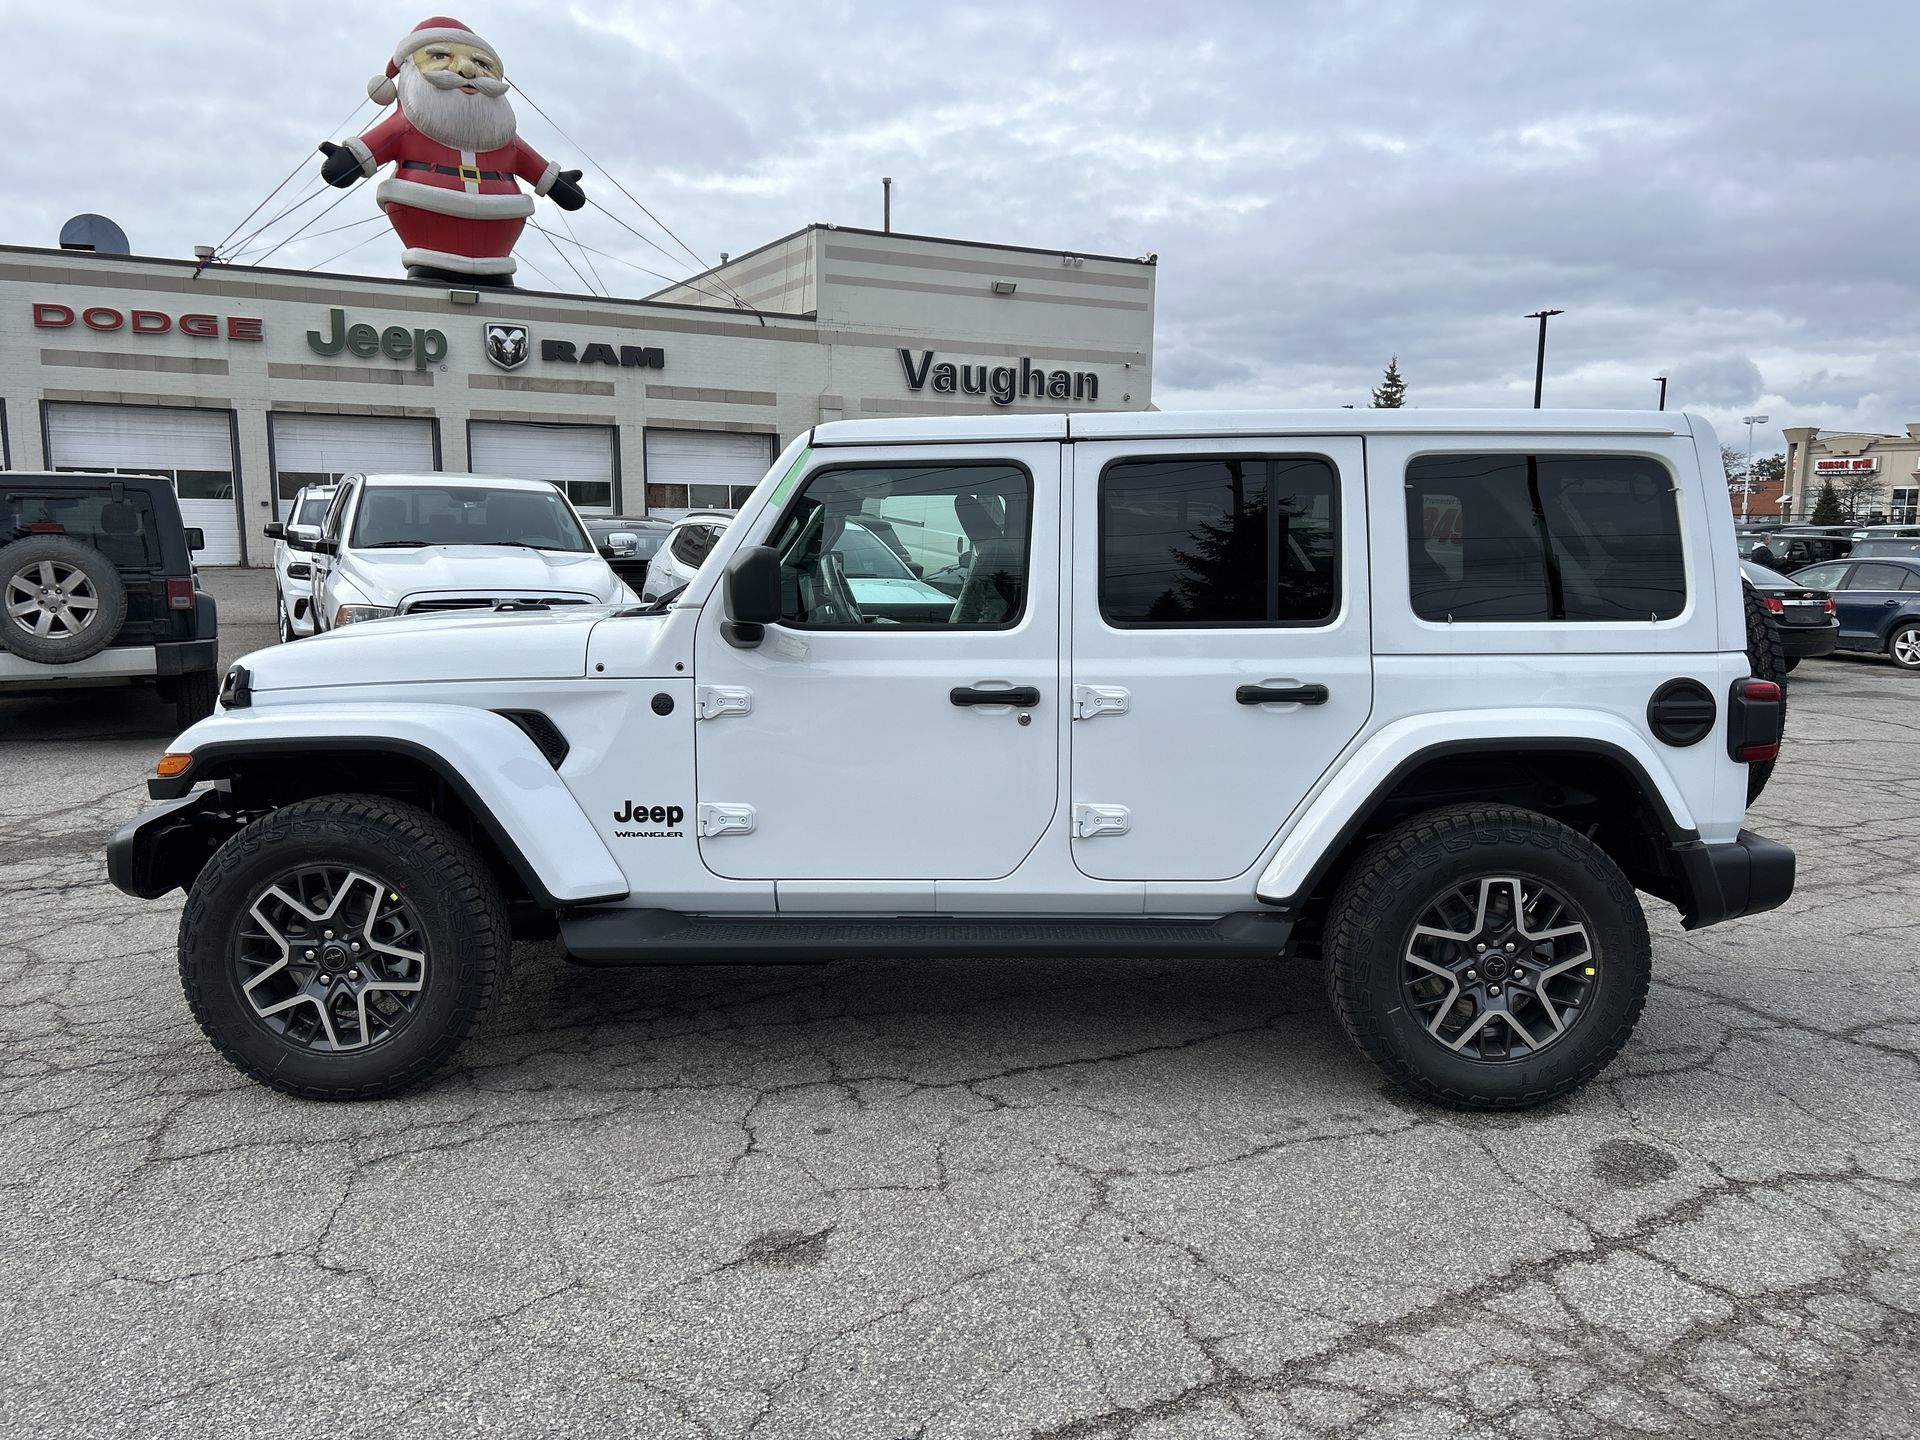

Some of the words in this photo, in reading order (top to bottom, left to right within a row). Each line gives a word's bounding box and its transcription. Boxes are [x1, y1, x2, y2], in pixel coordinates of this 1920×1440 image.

[33, 303, 264, 341] DODGE
[306, 308, 448, 371] Jeep
[540, 339, 665, 369] RAM
[898, 348, 1099, 406] Vaughan
[1817, 460, 1850, 470] sunset
[1853, 458, 1873, 470] grill
[613, 800, 684, 827] Jeep
